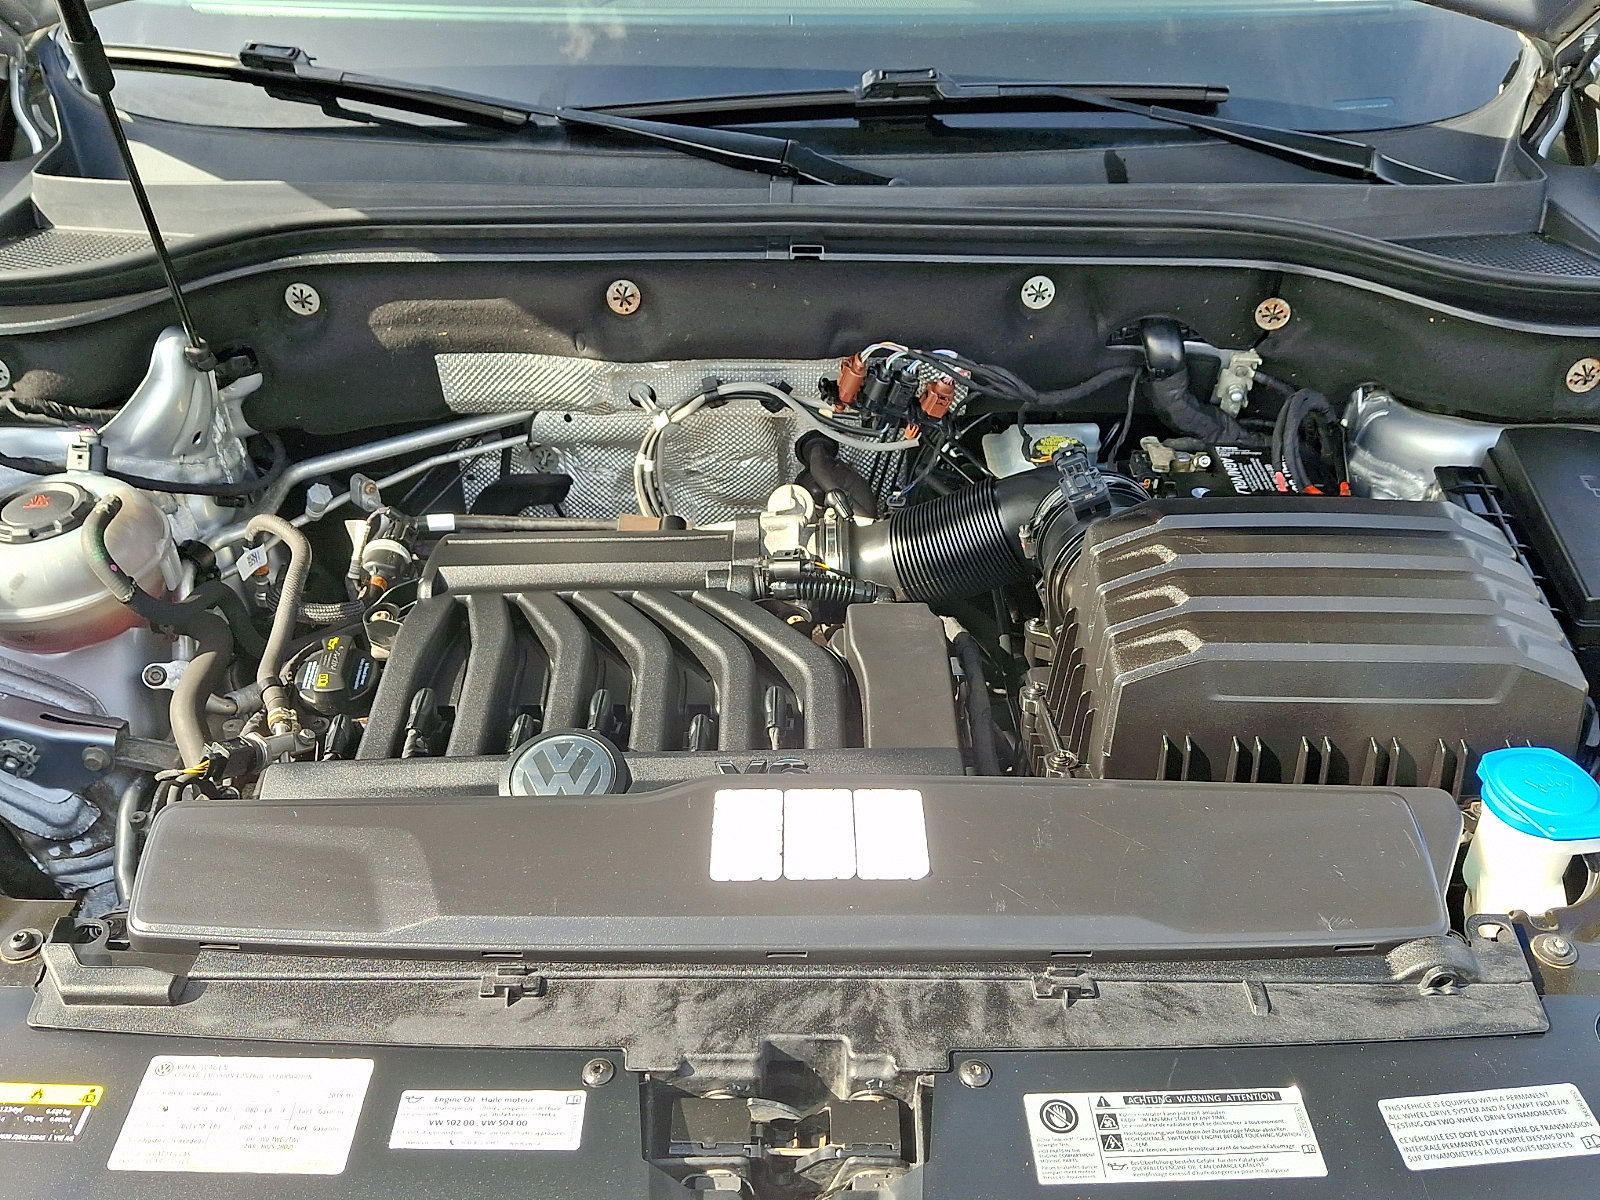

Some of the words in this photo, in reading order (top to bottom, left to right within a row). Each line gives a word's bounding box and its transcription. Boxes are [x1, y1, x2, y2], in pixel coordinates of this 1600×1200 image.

[1127, 1096, 1172, 1104] ACHTUNG
[1176, 1094, 1221, 1102] WARNING
[1224, 1092, 1275, 1101] ATTENTION
[1400, 1101, 1431, 1110] VEHICLE
[1440, 1098, 1477, 1107] EQUIPPED
[1505, 1091, 1548, 1100] PERMANENT
[1452, 1106, 1480, 1115] SYSTEM
[1506, 1101, 1533, 1110] EXEMPT
[1390, 1120, 1423, 1129] TESTING
[1436, 1115, 1483, 1125] TWO-WHEEL
[1397, 1136, 1409, 1144] CE
[1458, 1130, 1478, 1138] DOTÉ
[1540, 1121, 1592, 1130] TRANSMISSION
[1441, 1139, 1484, 1149] PERMANENT
